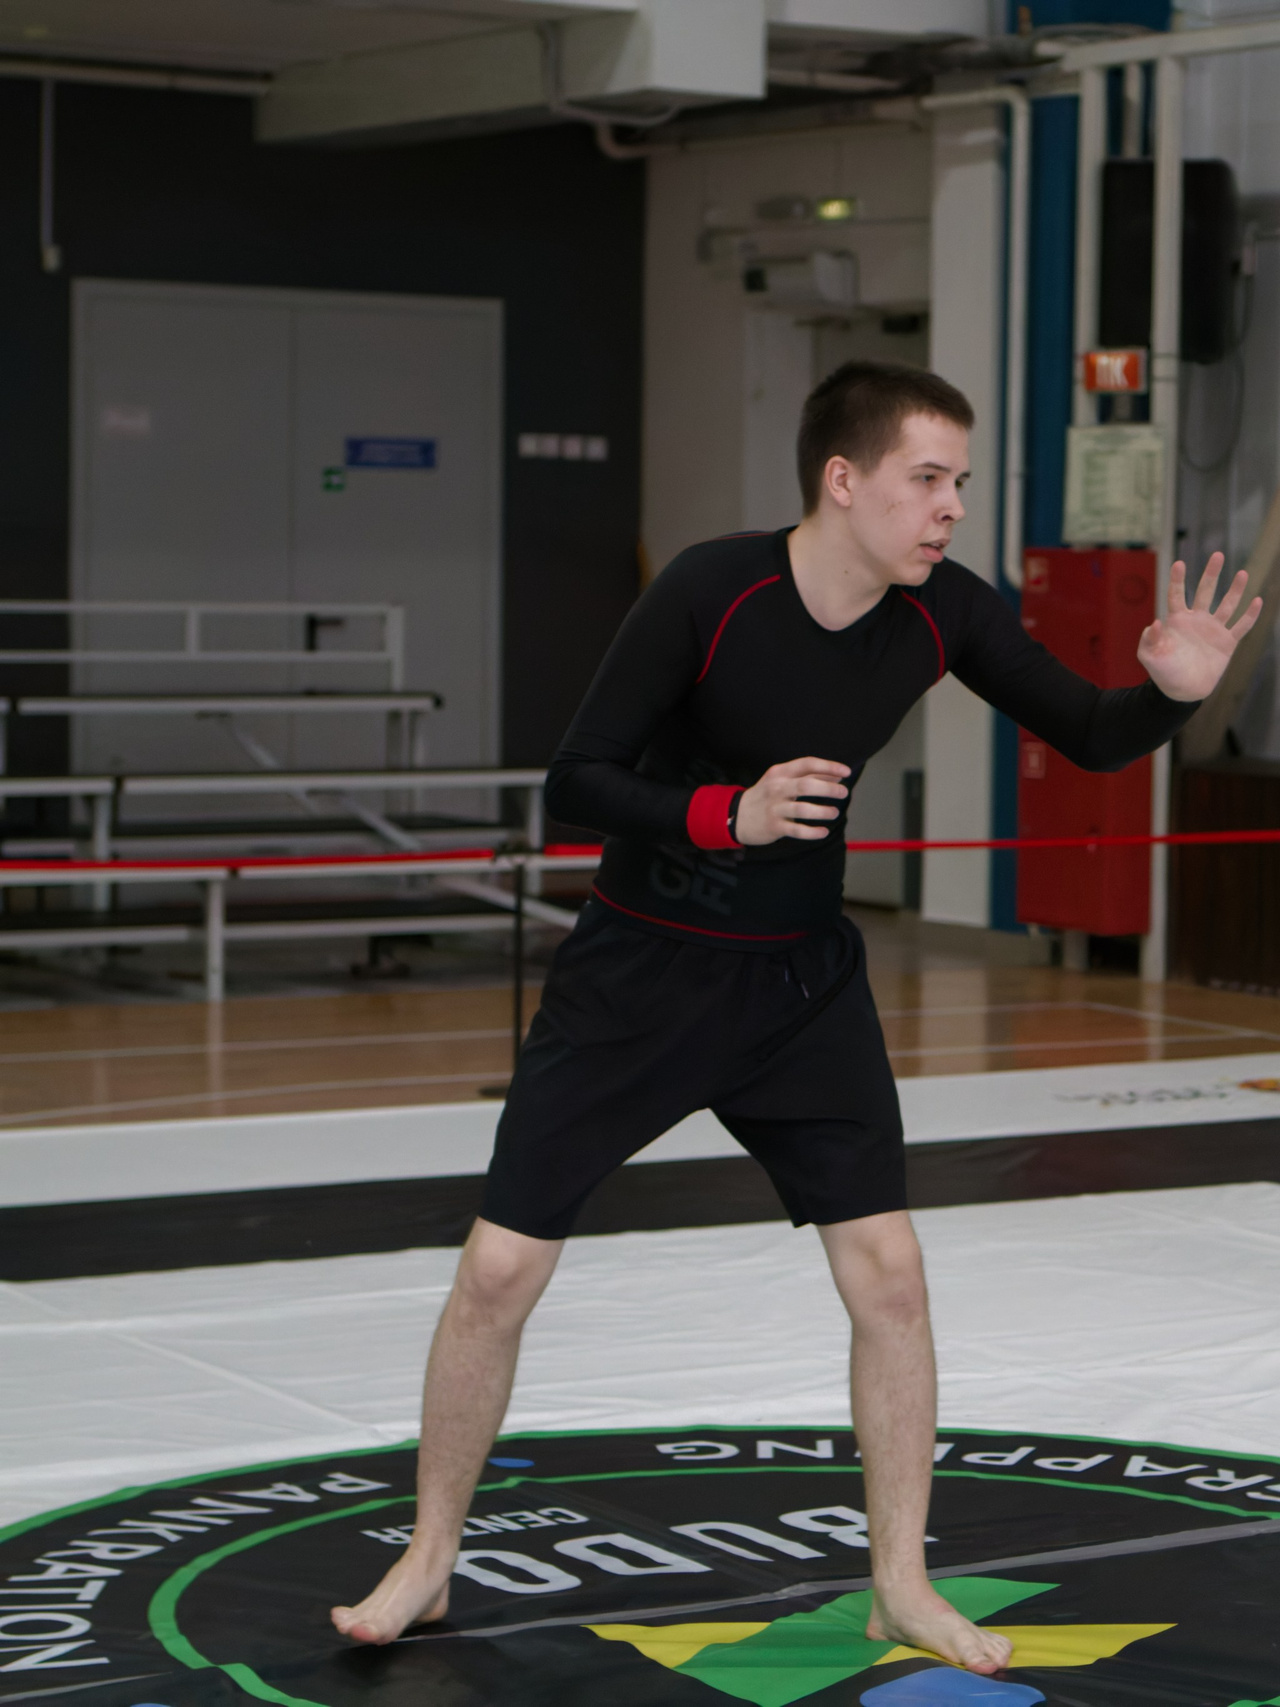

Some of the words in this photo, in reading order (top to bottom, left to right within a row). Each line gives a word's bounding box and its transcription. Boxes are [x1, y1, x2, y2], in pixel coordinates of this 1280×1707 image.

[360, 1507, 590, 1545] CENR
[453, 1505, 940, 1595] BUDO
[0, 1471, 392, 1673] PANKRATION
